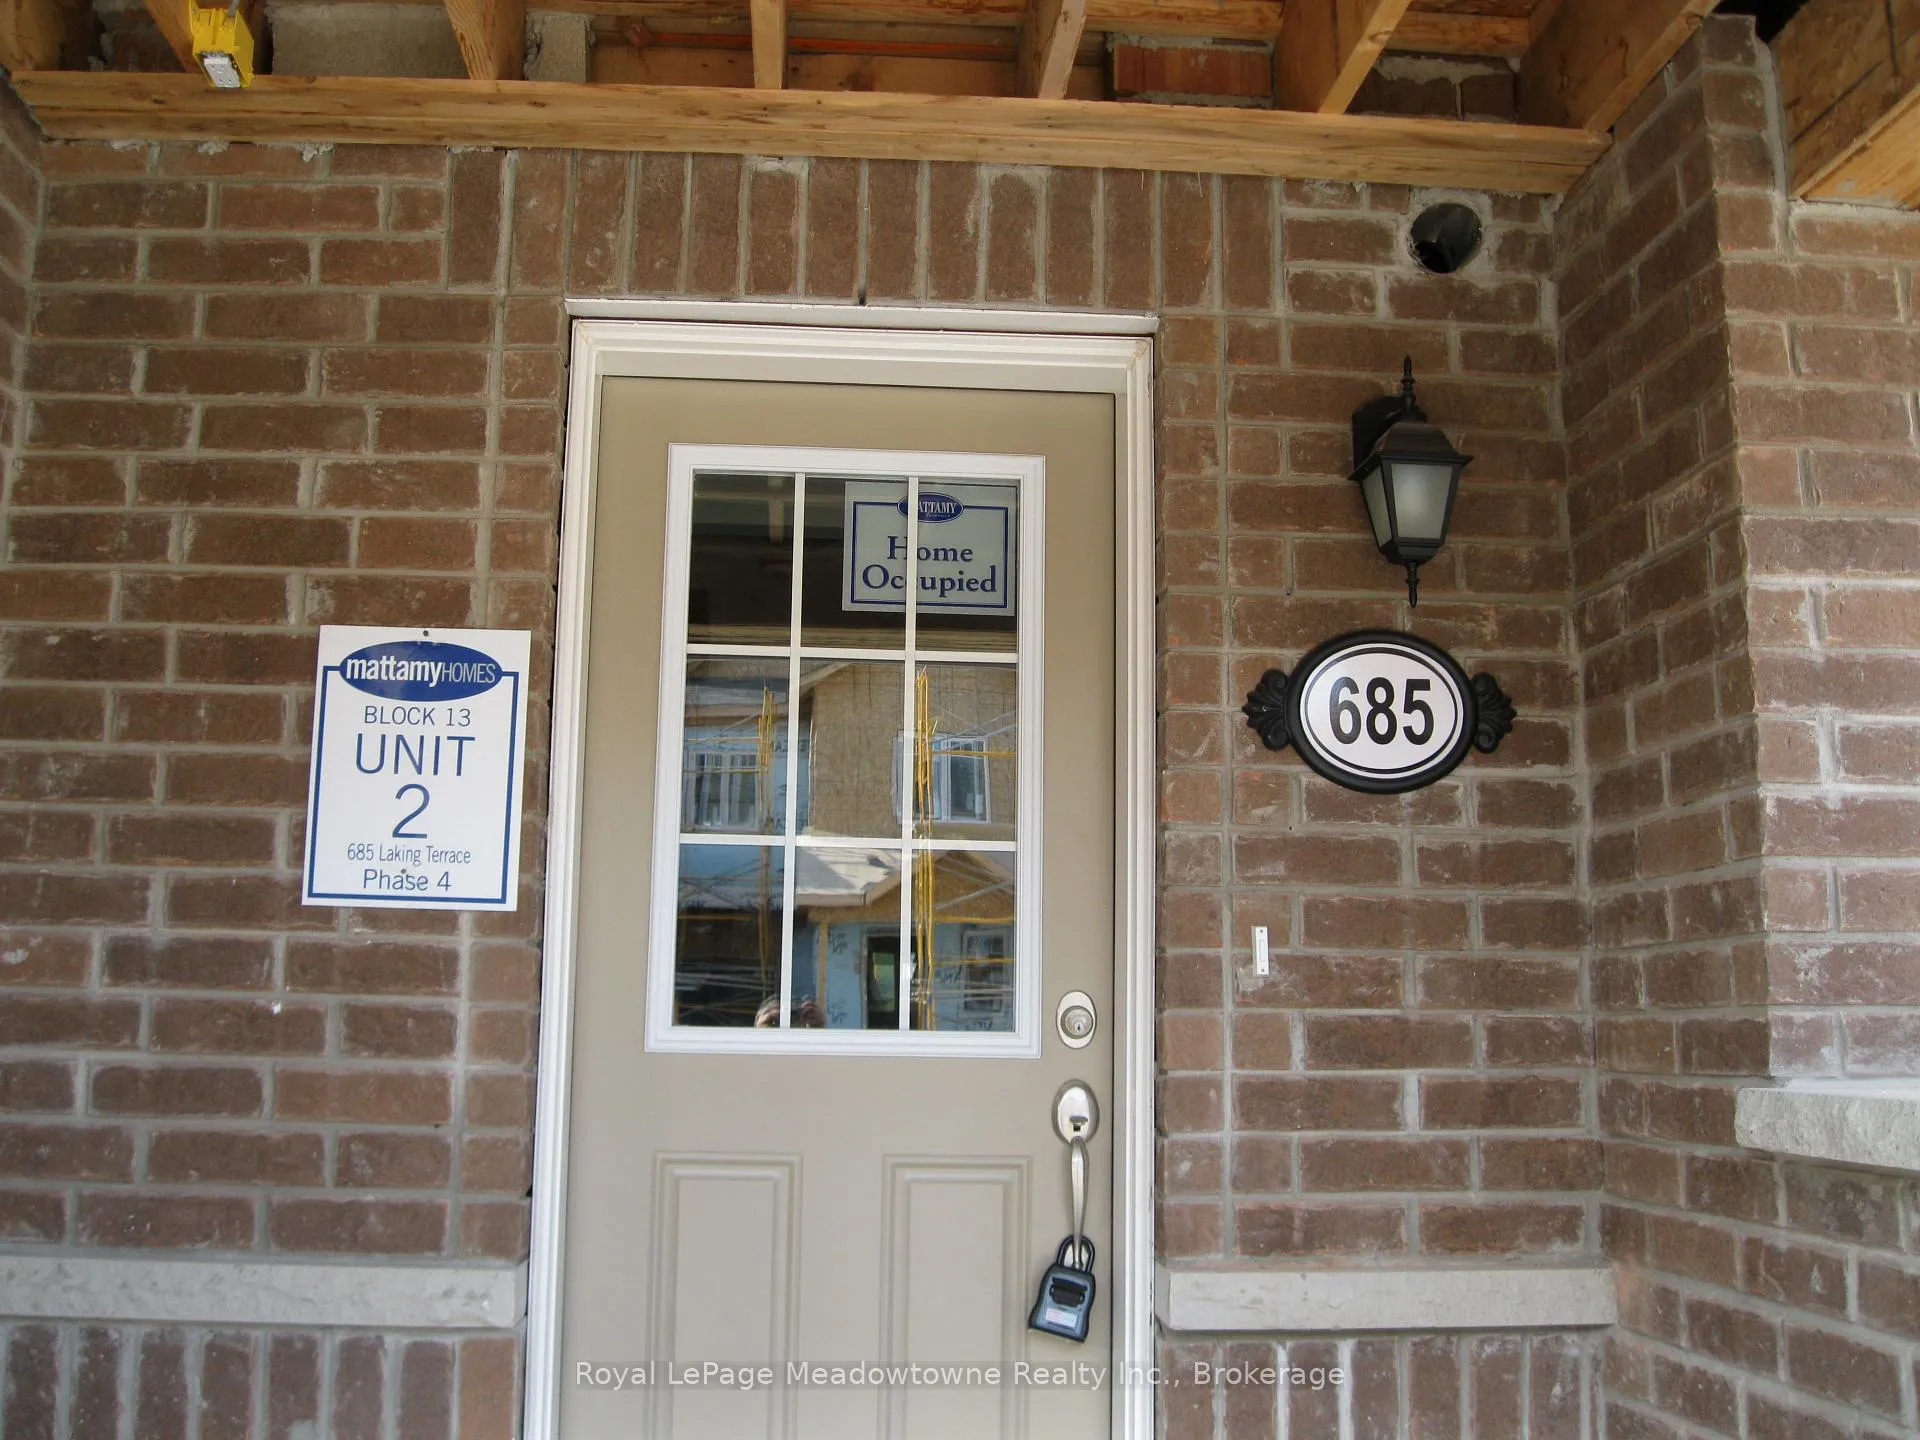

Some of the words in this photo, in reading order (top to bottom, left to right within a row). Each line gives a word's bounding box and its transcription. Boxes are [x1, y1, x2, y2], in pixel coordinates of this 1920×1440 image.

[918, 501, 957, 514] ATTAMY
[887, 535, 974, 562] Home
[862, 564, 997, 598] Ocupied
[364, 705, 436, 726] BLOCK
[446, 707, 472, 727] 13
[1328, 676, 1435, 746] 685
[355, 733, 476, 777] UNIT
[392, 783, 431, 839] 2
[347, 842, 374, 862] 685
[379, 845, 422, 864] Laking
[426, 844, 472, 865] Terrace
[363, 868, 429, 891] Phase
[436, 870, 452, 892] 4
